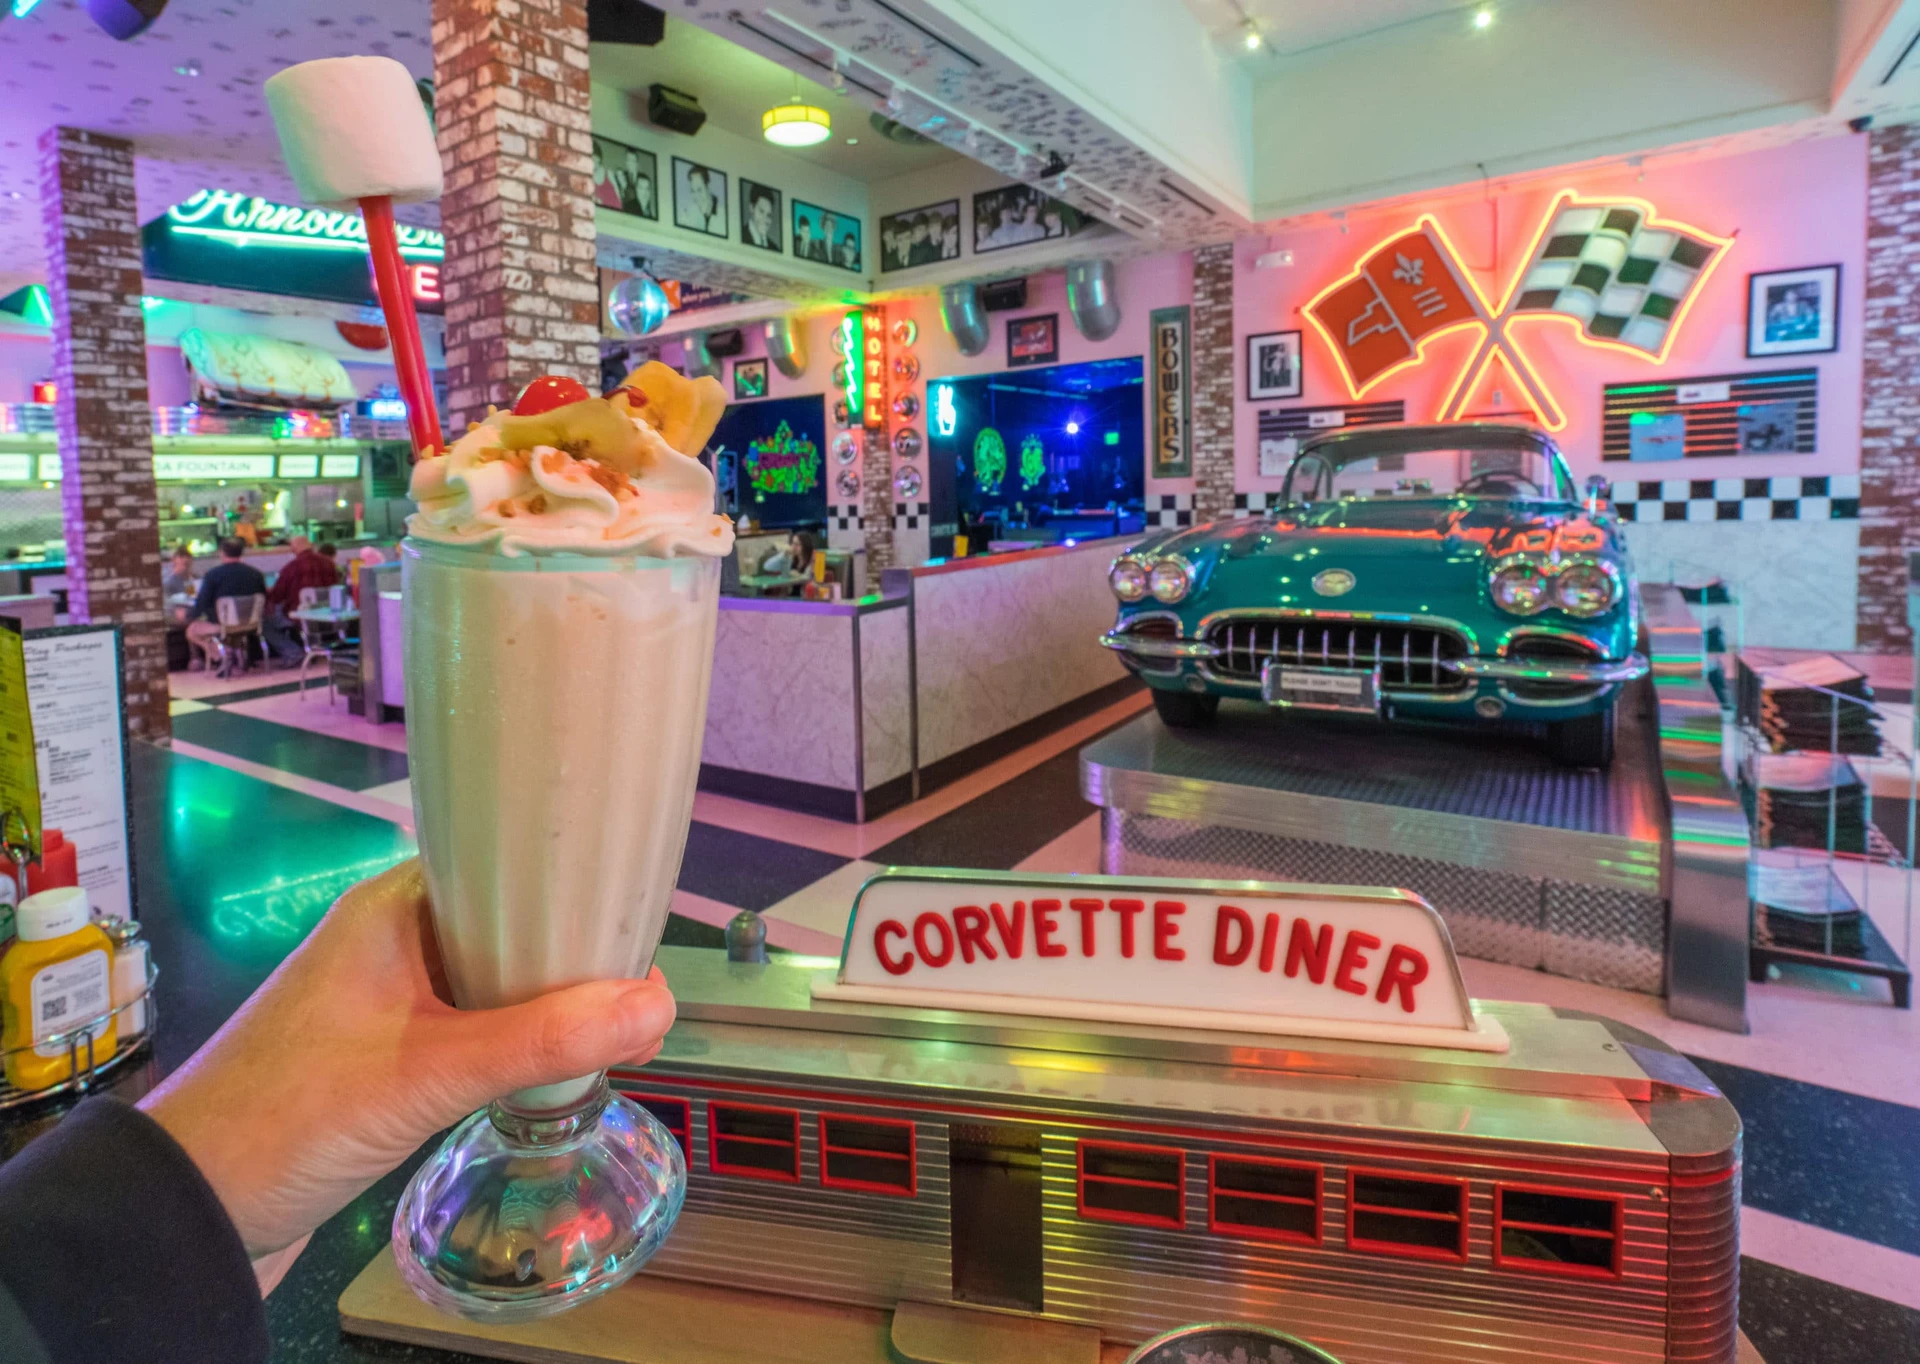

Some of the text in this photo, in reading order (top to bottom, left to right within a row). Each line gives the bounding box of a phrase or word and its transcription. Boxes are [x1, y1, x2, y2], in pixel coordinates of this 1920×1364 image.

[1162, 328, 1180, 459] BOWERS
[177, 461, 252, 472] FOUNTAIN
[874, 898, 1429, 1014] CORVETTE DINER
